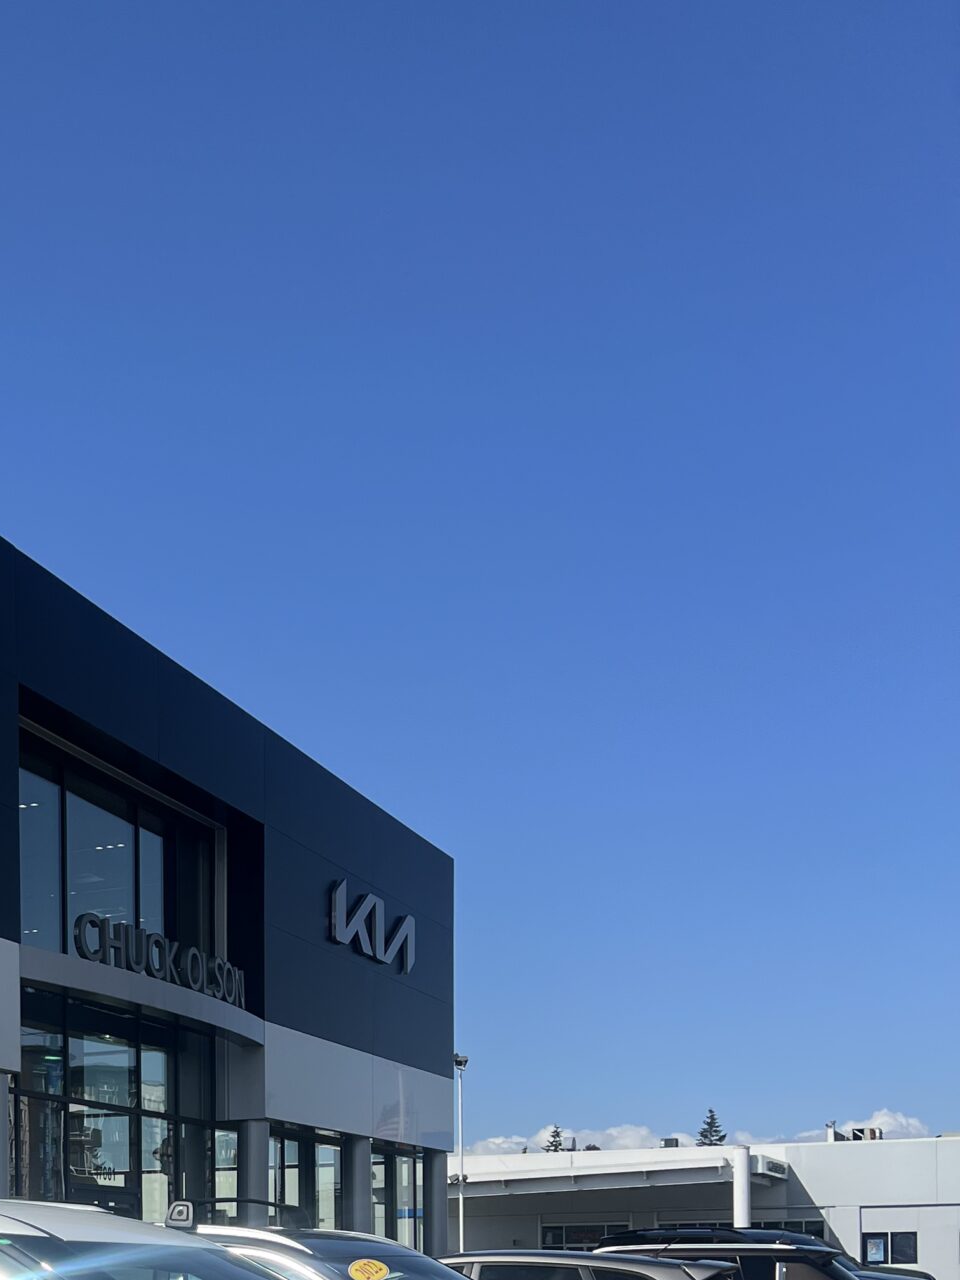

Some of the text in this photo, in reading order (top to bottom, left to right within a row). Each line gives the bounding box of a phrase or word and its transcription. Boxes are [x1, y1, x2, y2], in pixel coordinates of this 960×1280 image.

[73, 912, 247, 1009] CHUCK OLSON
[331, 878, 416, 976] KIA
